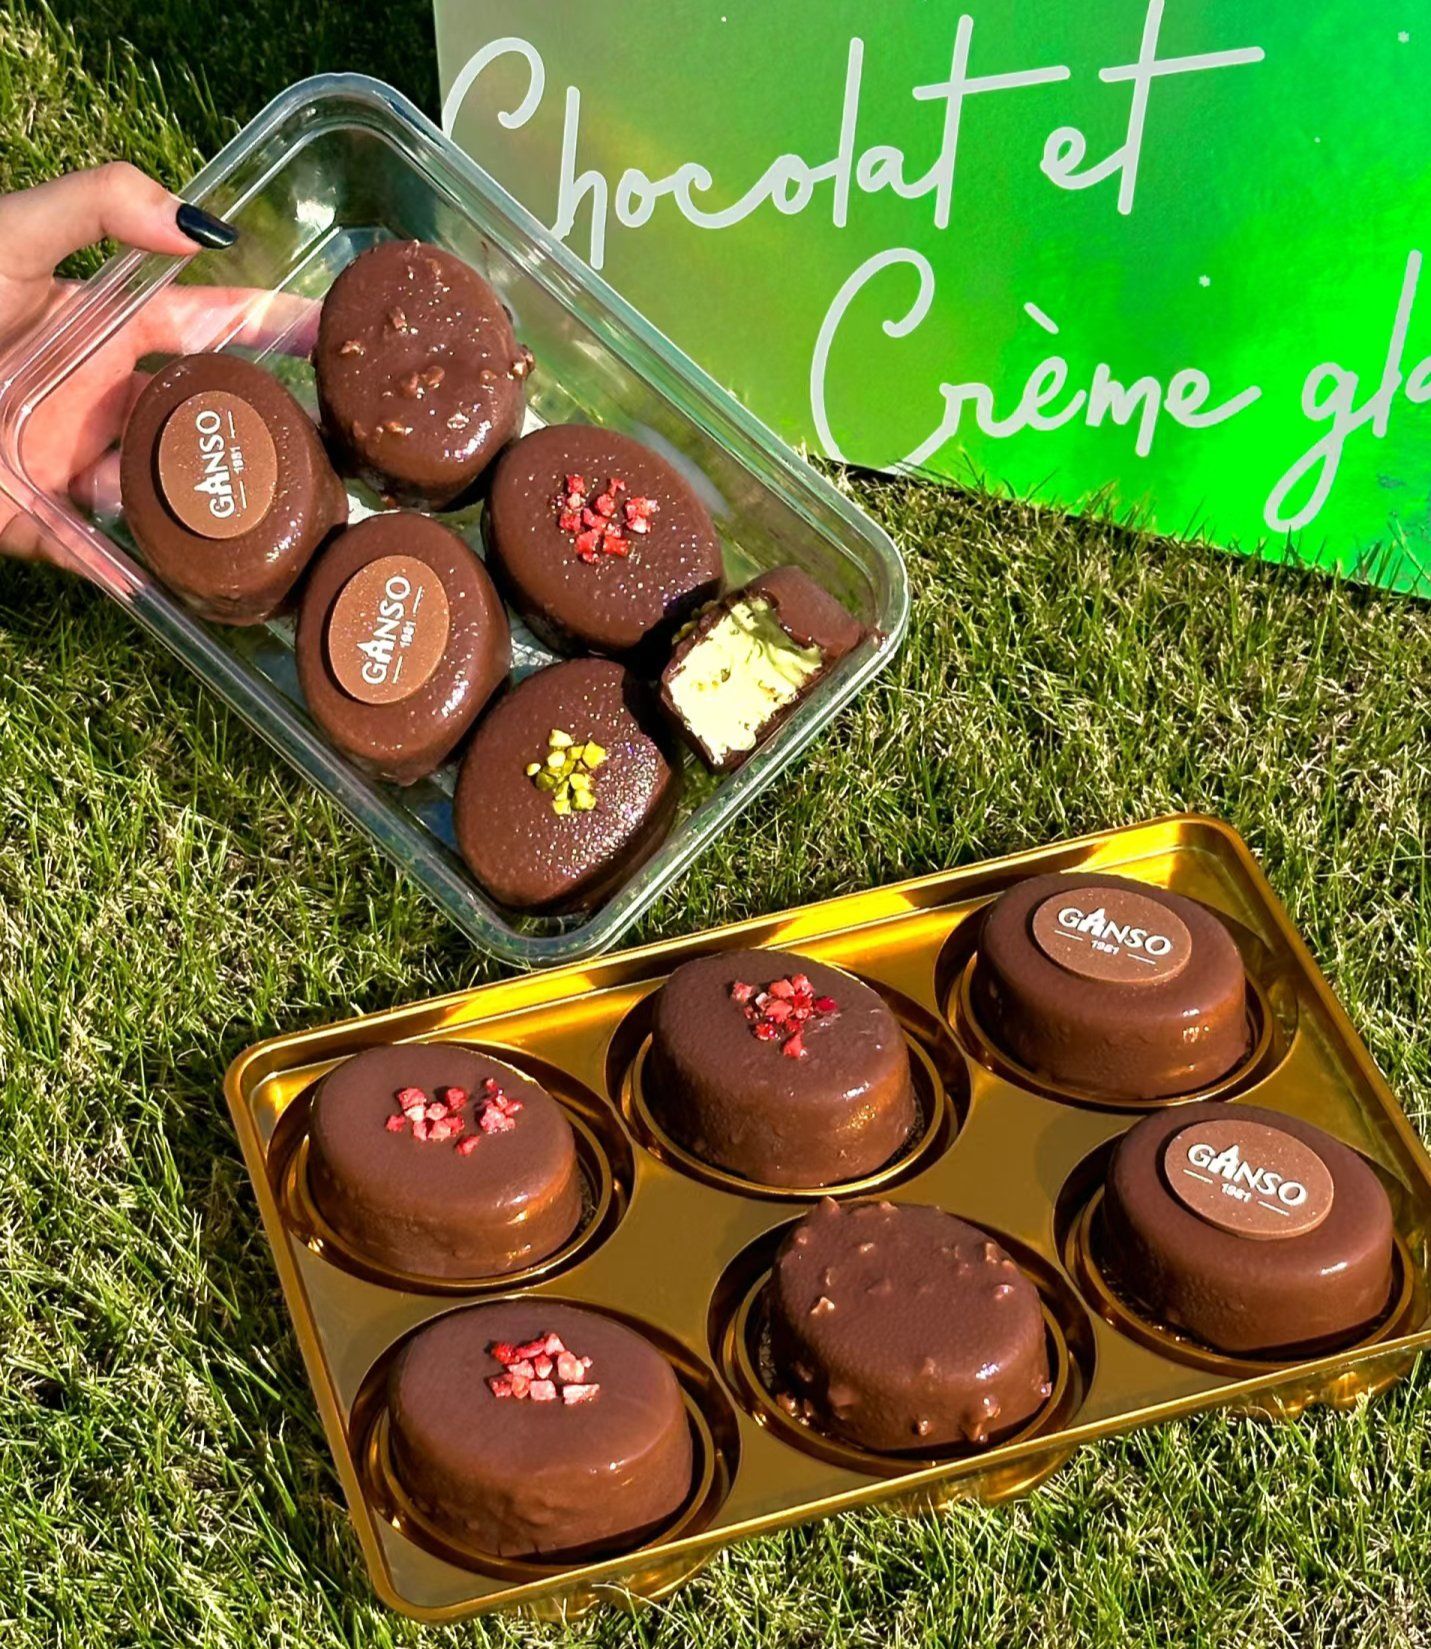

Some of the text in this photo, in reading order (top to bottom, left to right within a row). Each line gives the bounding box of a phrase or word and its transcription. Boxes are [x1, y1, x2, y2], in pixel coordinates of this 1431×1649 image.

[441, 0, 1265, 270] Chocolat et
[811, 247, 1261, 475] Crème
[194, 410, 235, 518] GANSO
[357, 576, 410, 685] GANSO
[1058, 907, 1172, 956] GANSO
[1187, 1144, 1308, 1206] GANSO
